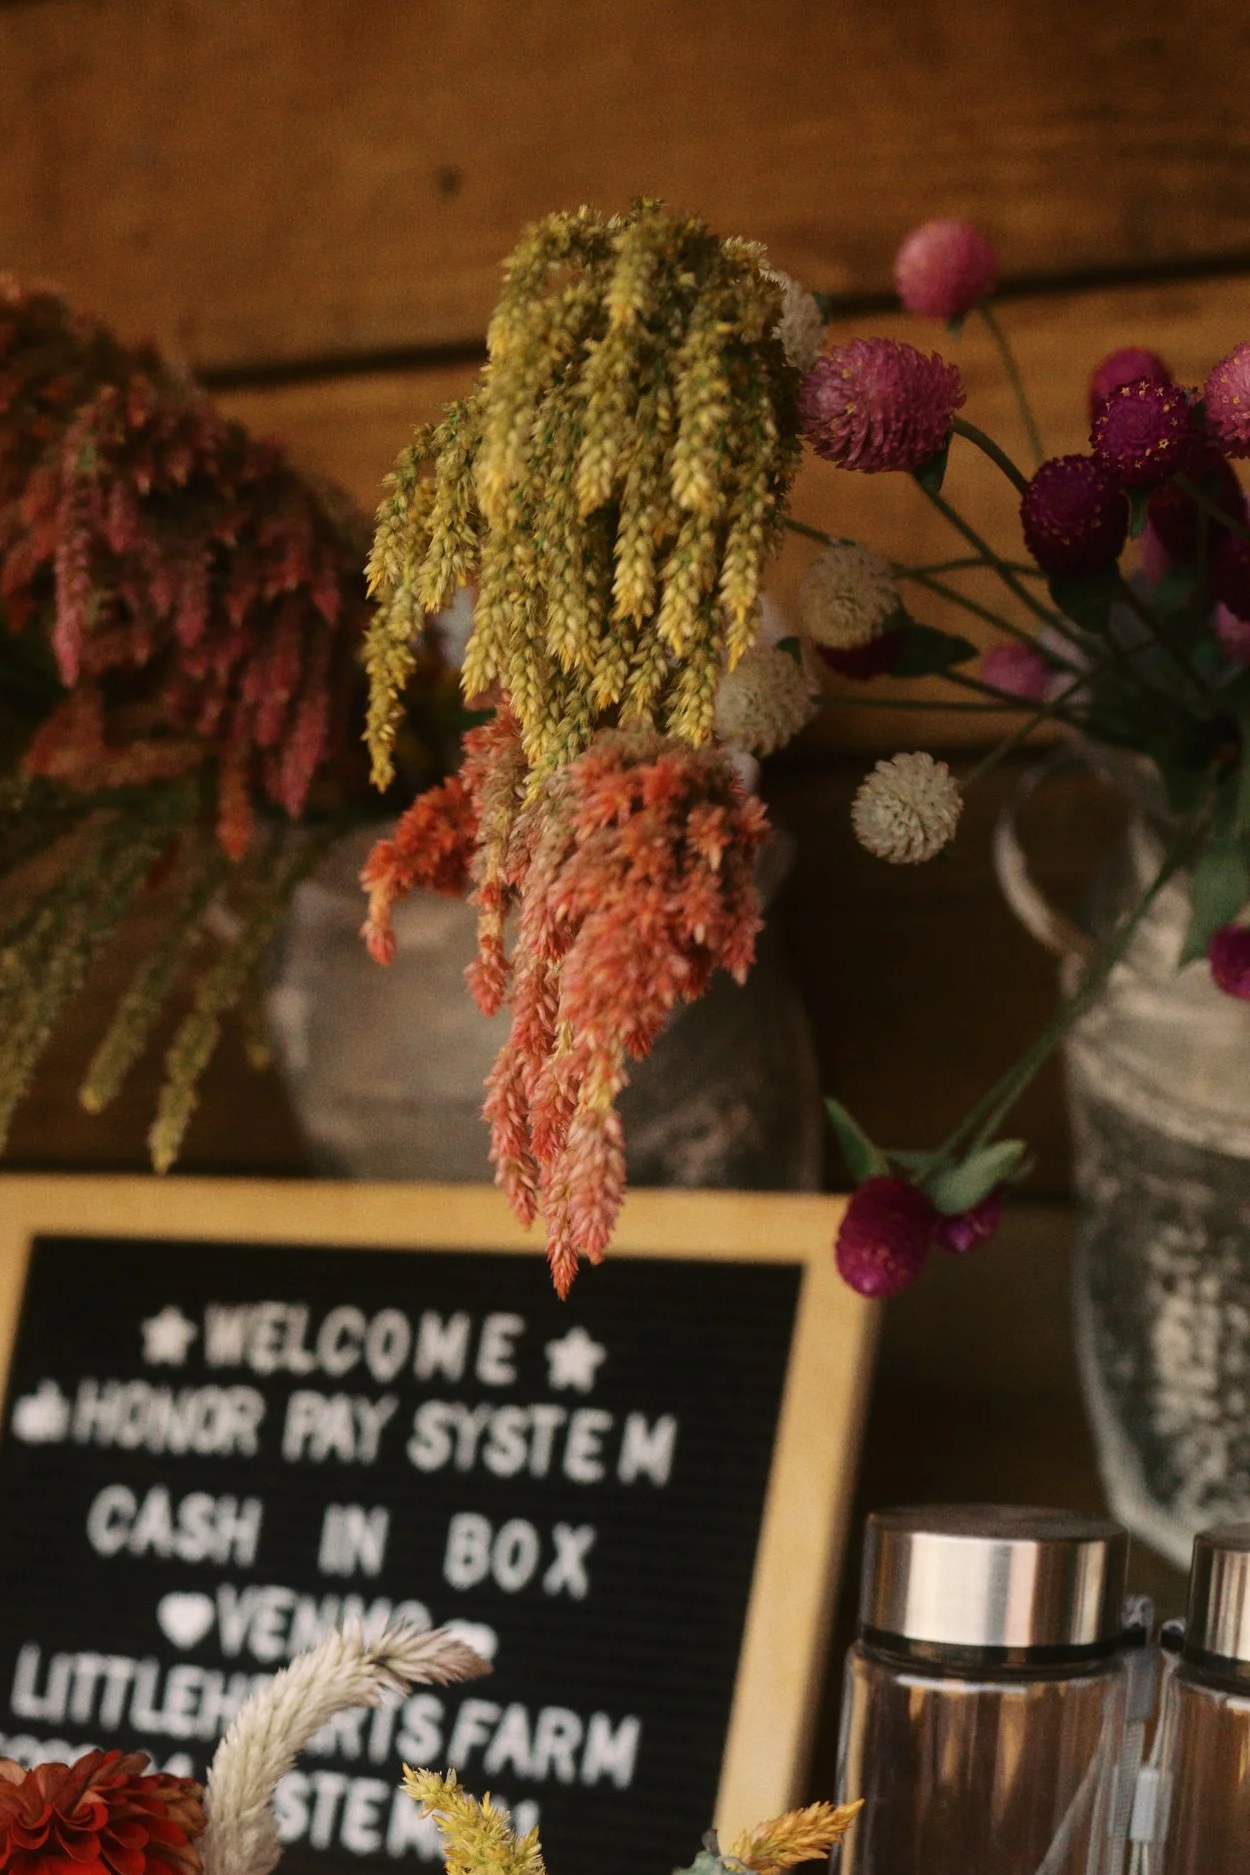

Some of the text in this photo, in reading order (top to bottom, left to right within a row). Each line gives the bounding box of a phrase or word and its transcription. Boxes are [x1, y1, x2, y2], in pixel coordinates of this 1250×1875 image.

[204, 1300, 526, 1386] WELCOME
[72, 1377, 679, 1487] HONOR PAY SYSTEM
[85, 1484, 597, 1599] CASH IN BOX
